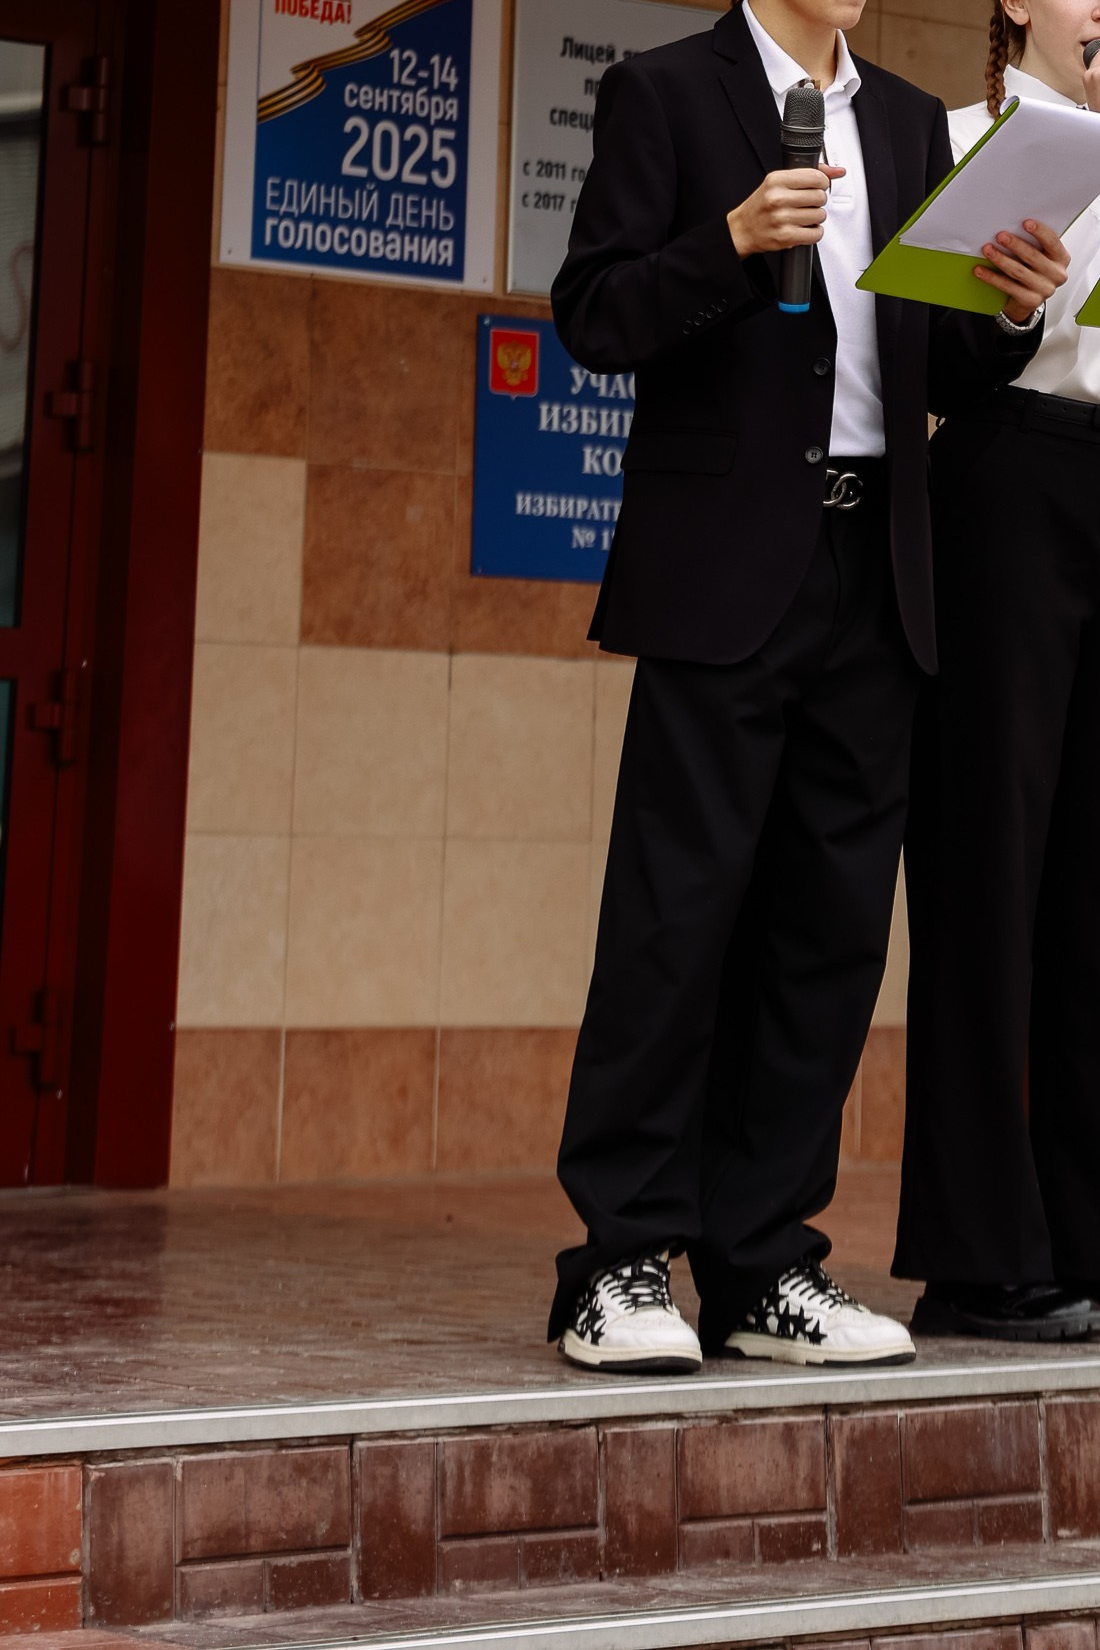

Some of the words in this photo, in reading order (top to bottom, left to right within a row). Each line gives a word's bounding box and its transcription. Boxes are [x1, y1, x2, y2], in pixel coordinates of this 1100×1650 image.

[389, 48, 458, 92] 12-14
[560, 36, 616, 64] Лицей
[344, 82, 458, 126] сентября
[341, 115, 457, 189] 2025
[536, 159, 566, 181] 2011
[266, 176, 379, 223] ЕДИНЫЙ
[385, 192, 455, 232] ДЕНЬ
[534, 190, 565, 212] 2017
[264, 216, 454, 267] голосования
